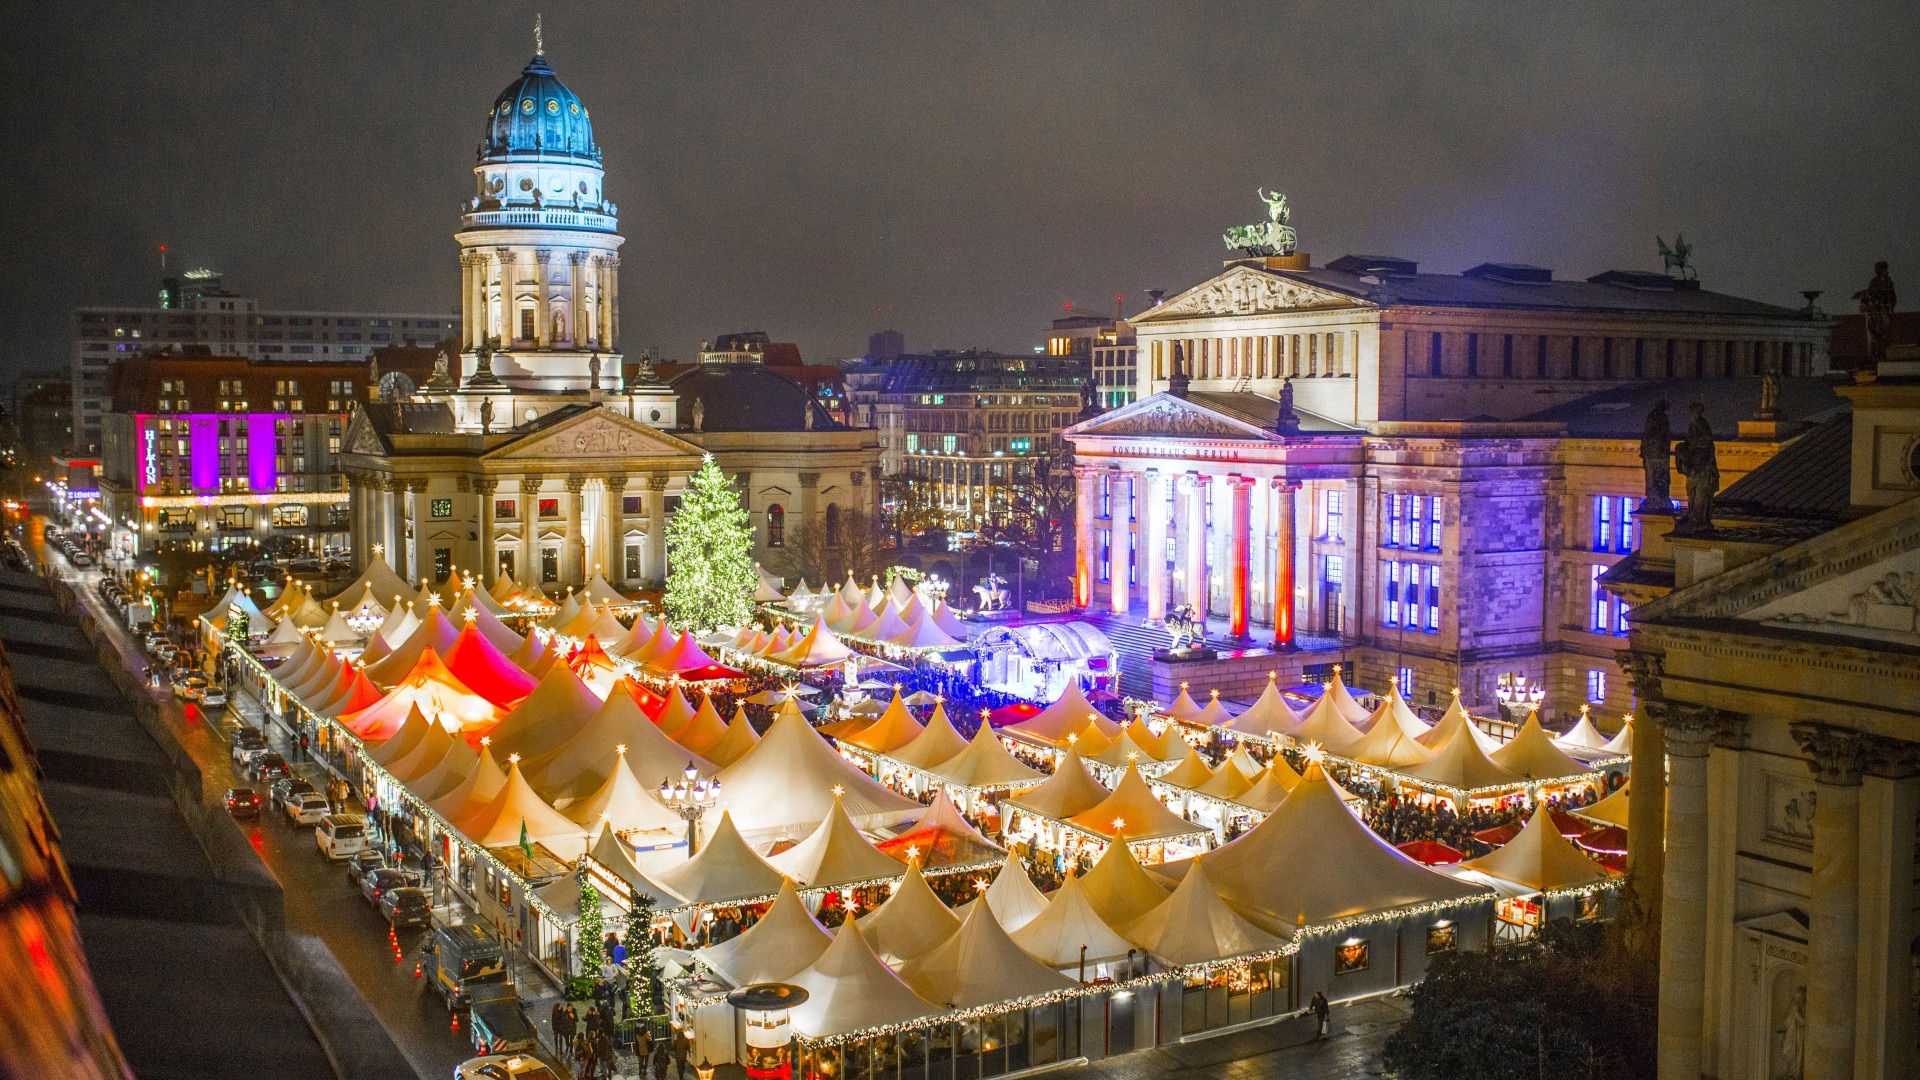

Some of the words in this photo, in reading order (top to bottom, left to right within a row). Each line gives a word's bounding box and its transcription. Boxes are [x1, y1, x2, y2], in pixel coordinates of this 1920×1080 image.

[144, 430, 157, 484] HILTON
[1112, 446, 1187, 458] KONZERTHAUS
[1195, 449, 1239, 460] BERLIN
